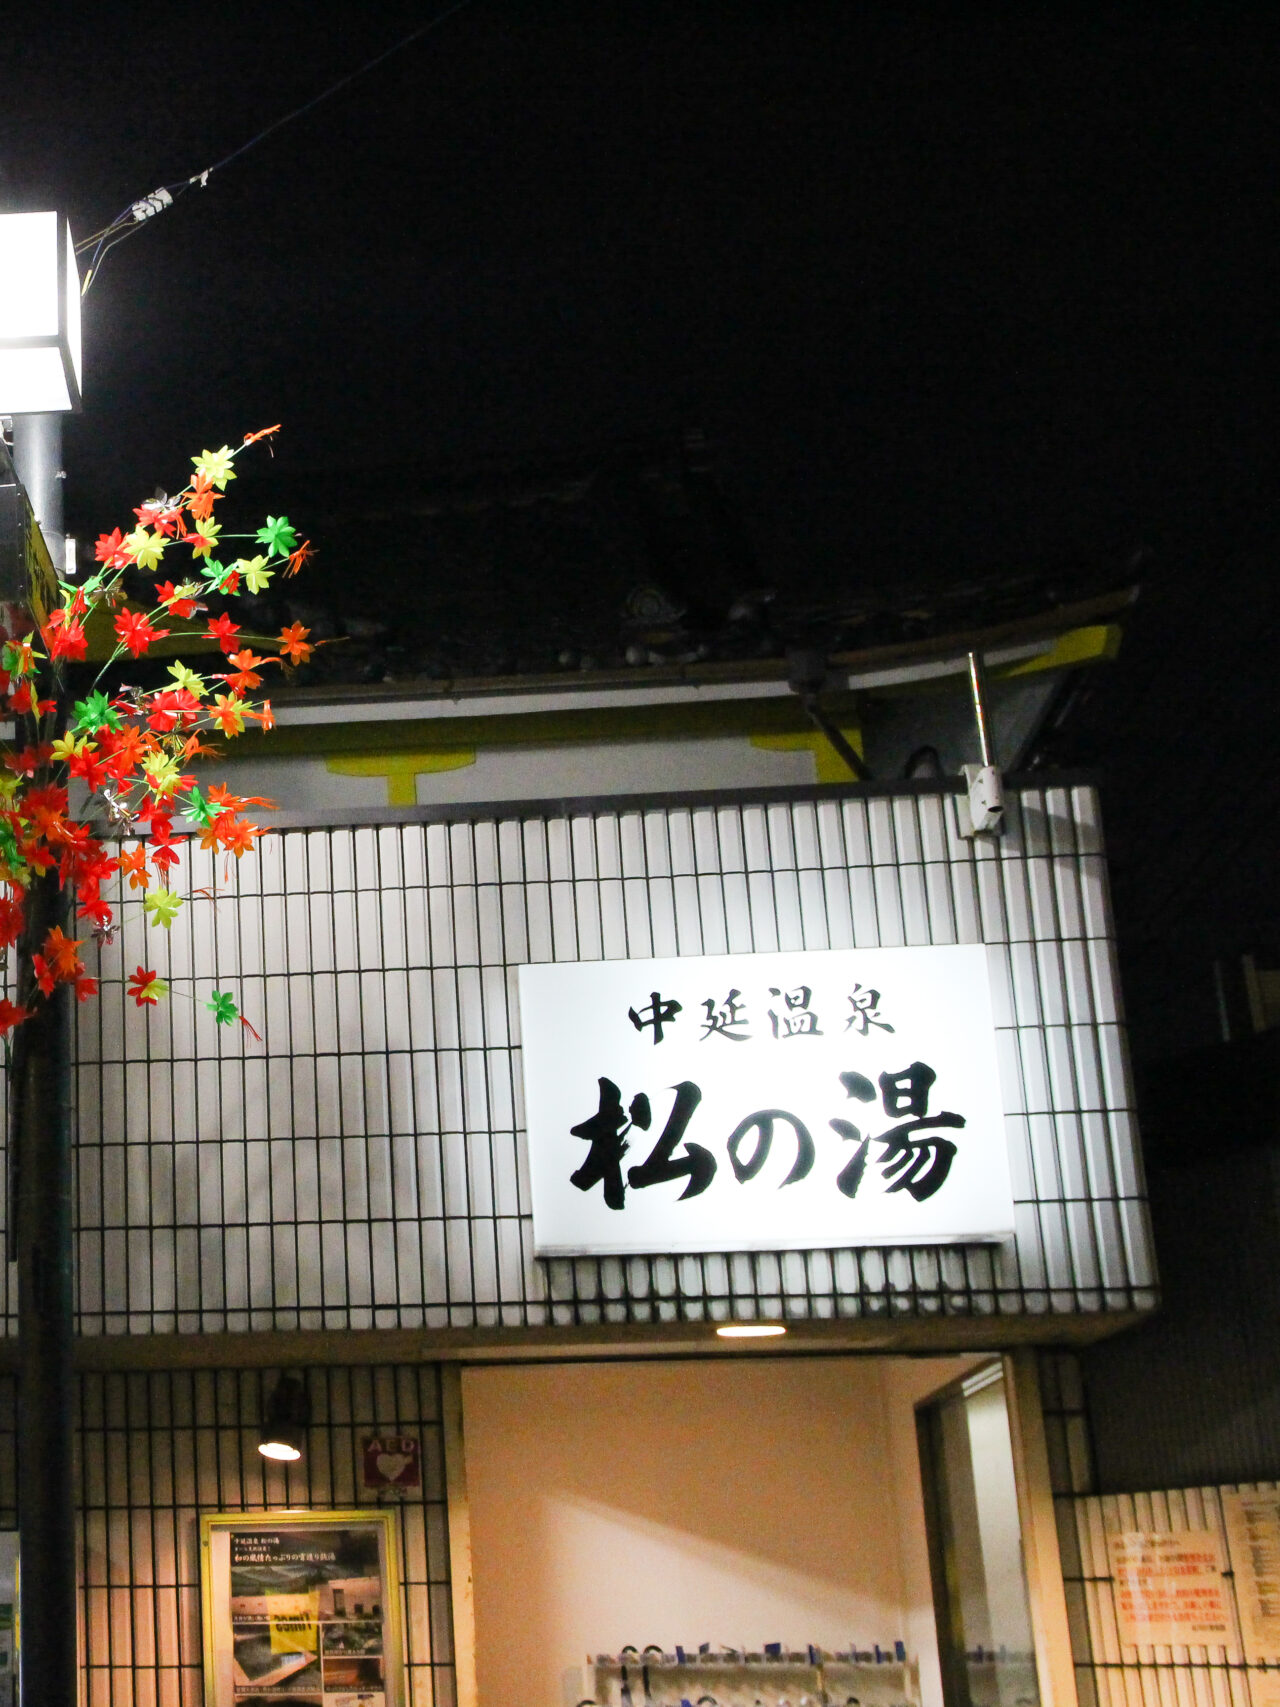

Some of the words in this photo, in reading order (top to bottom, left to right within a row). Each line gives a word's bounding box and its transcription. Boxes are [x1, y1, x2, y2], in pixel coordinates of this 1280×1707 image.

[628, 983, 896, 1045] 中延温泉
[569, 1061, 967, 1211] 松の湯
[367, 1439, 415, 1452] AED
